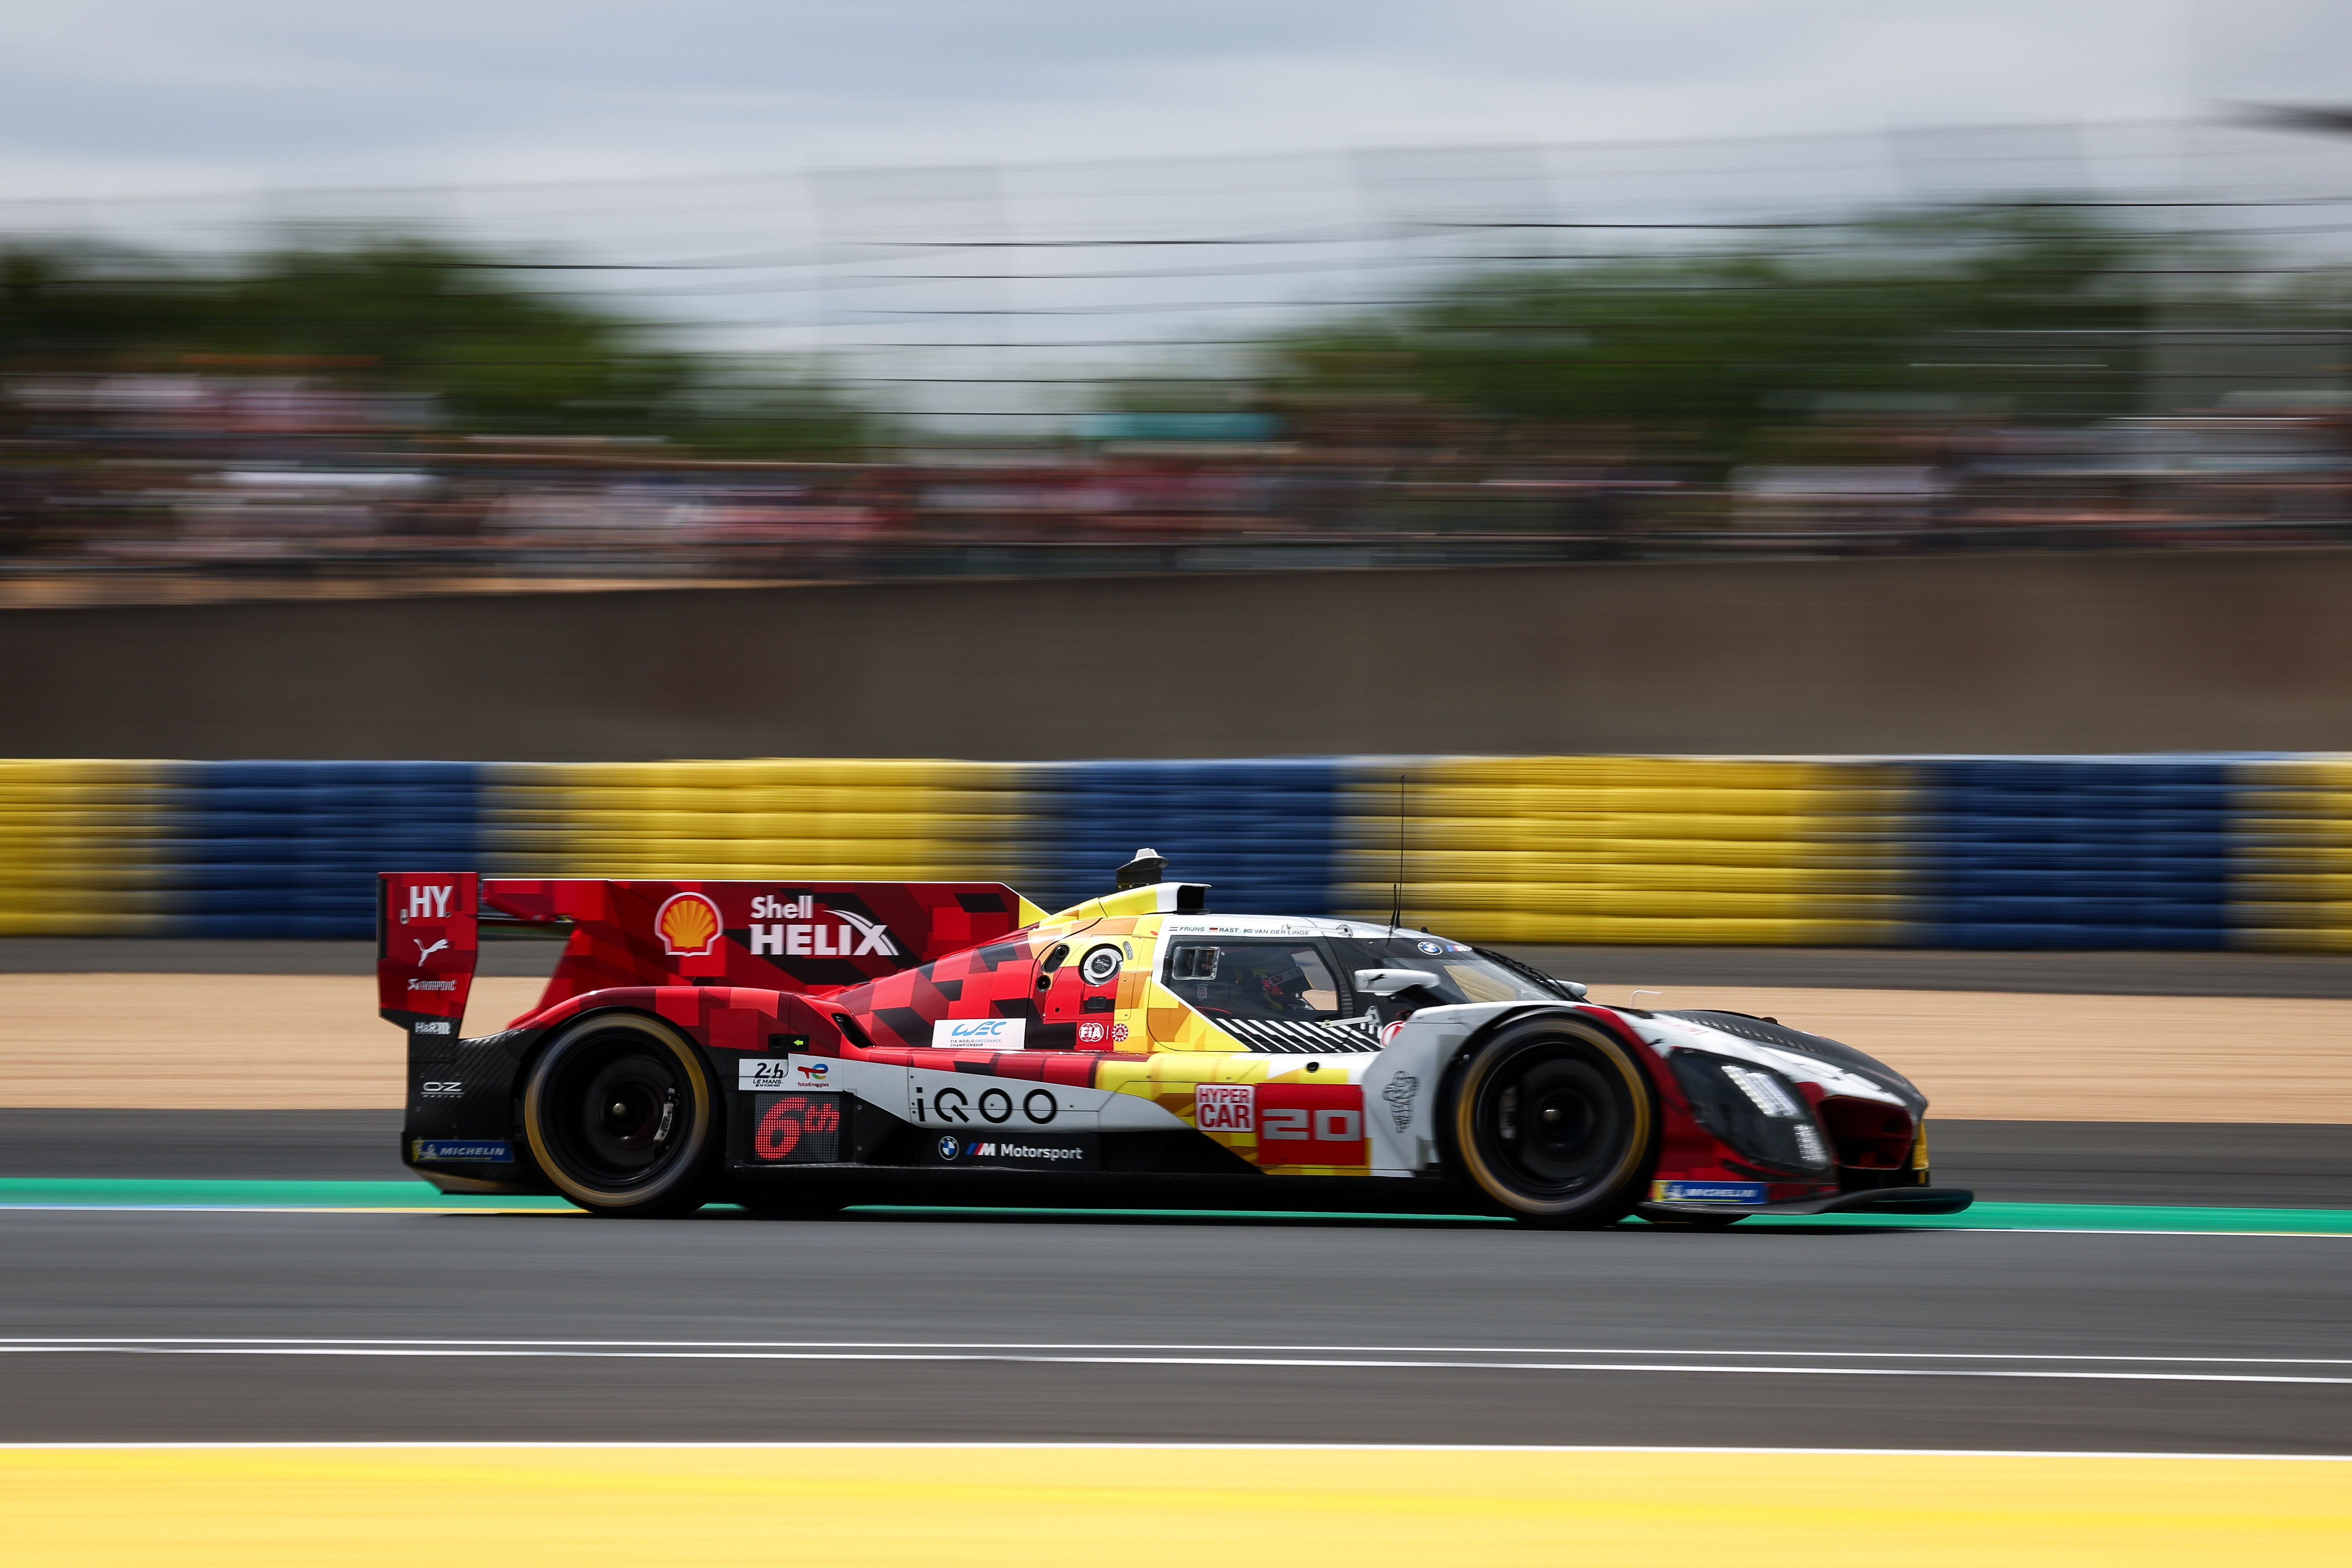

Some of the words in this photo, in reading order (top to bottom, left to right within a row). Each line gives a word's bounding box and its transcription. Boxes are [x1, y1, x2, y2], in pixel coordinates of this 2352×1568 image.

[410, 886, 453, 917] HY
[750, 895, 814, 919] Shell
[748, 916, 899, 956] HELIX
[951, 1021, 1007, 1036] WEC
[1200, 1088, 1251, 1104] HYPER
[1201, 1104, 1251, 1128] CAR
[1262, 1108, 1362, 1141] 20
[755, 1097, 840, 1161] 6th
[440, 1147, 505, 1156] MICHELIN
[1001, 1143, 1084, 1161] Motorsport
